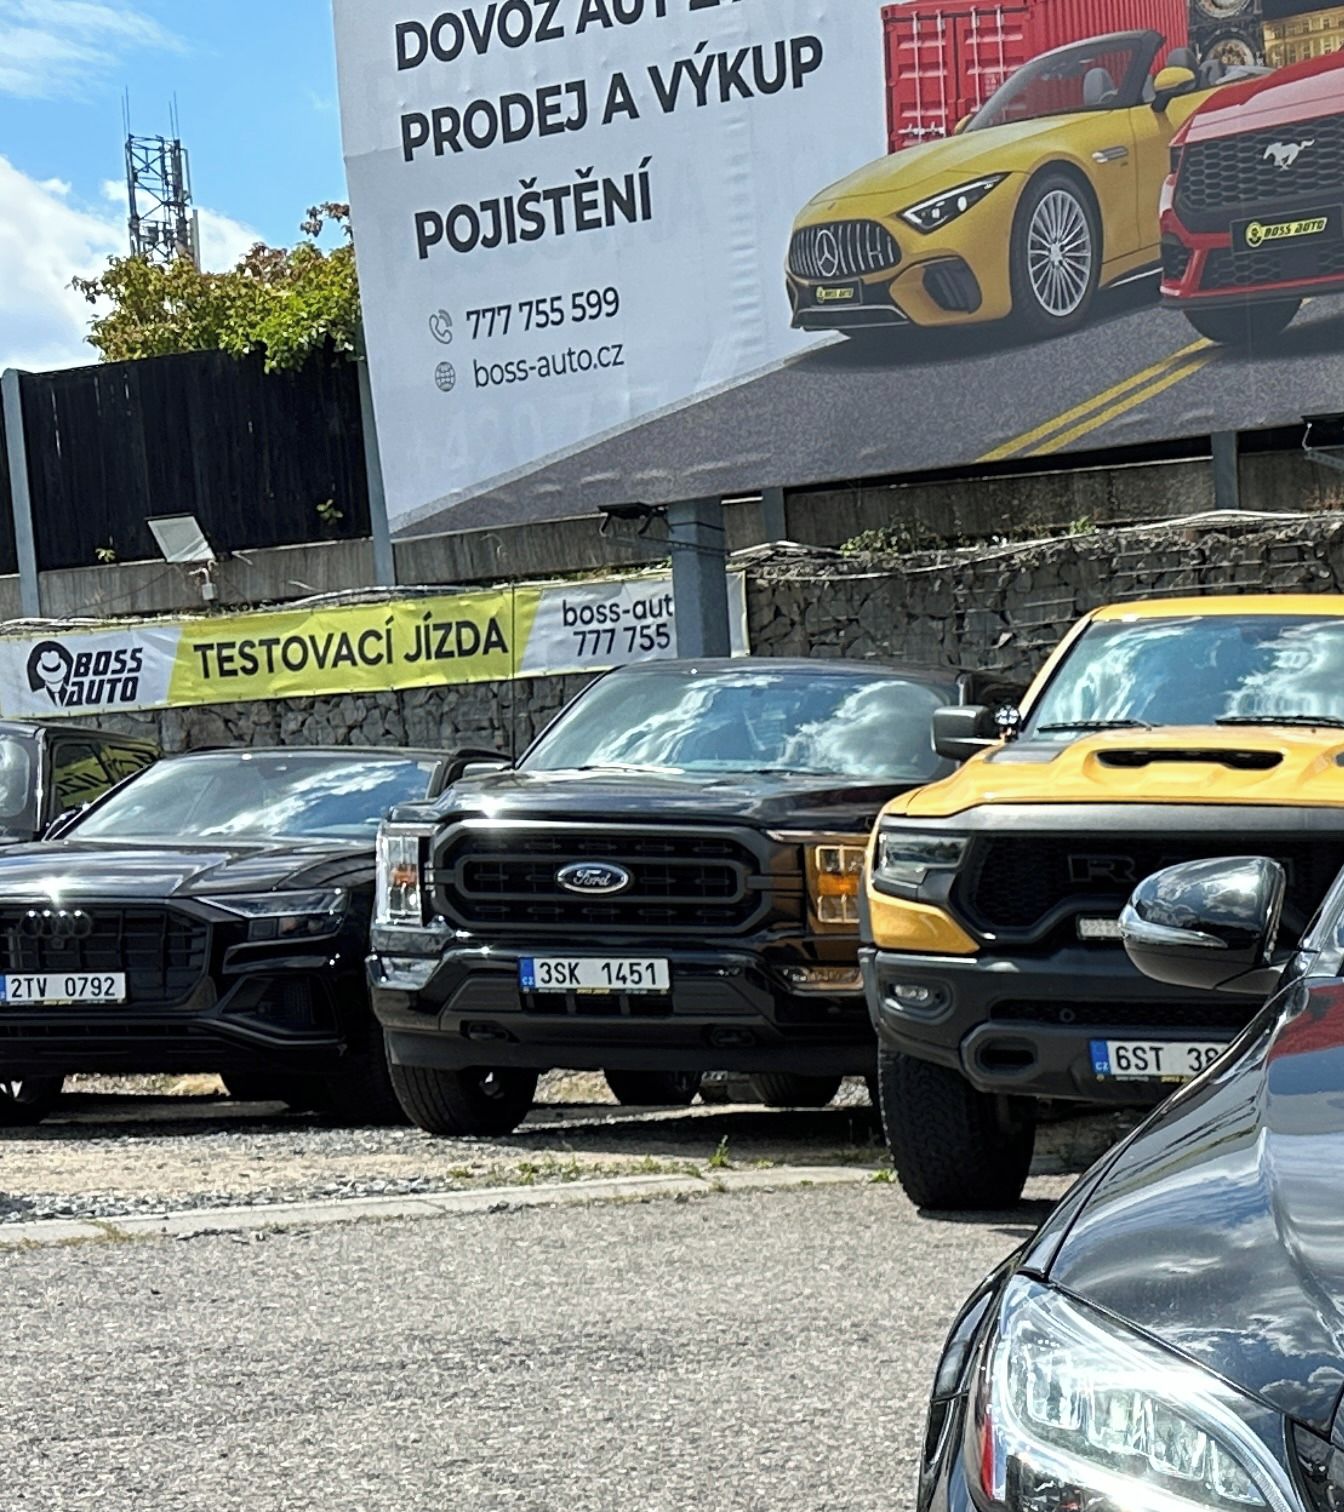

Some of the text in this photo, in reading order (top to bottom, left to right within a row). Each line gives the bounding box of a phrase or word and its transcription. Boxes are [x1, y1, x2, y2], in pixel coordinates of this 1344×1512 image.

[395, 0, 565, 72] DOVOZ
[400, 35, 823, 162] PRODEJ A VÝKUP
[414, 156, 653, 260] POJIŠTĚNÍ
[466, 286, 620, 340] 777 755 599
[473, 343, 625, 388] boss-auto.cz
[562, 593, 674, 627] boss-aut
[193, 610, 509, 679] TESTOVACÍ JÍZDA
[573, 623, 671, 657] 777 755
[73, 647, 144, 678] BOSS
[64, 676, 140, 707] AUTO
[573, 869, 611, 886] Ford
[10, 977, 47, 998] 2TV
[64, 976, 116, 998] 0792
[539, 961, 657, 985] 3SK 1451
[1115, 1046, 1165, 1072] 6ST
